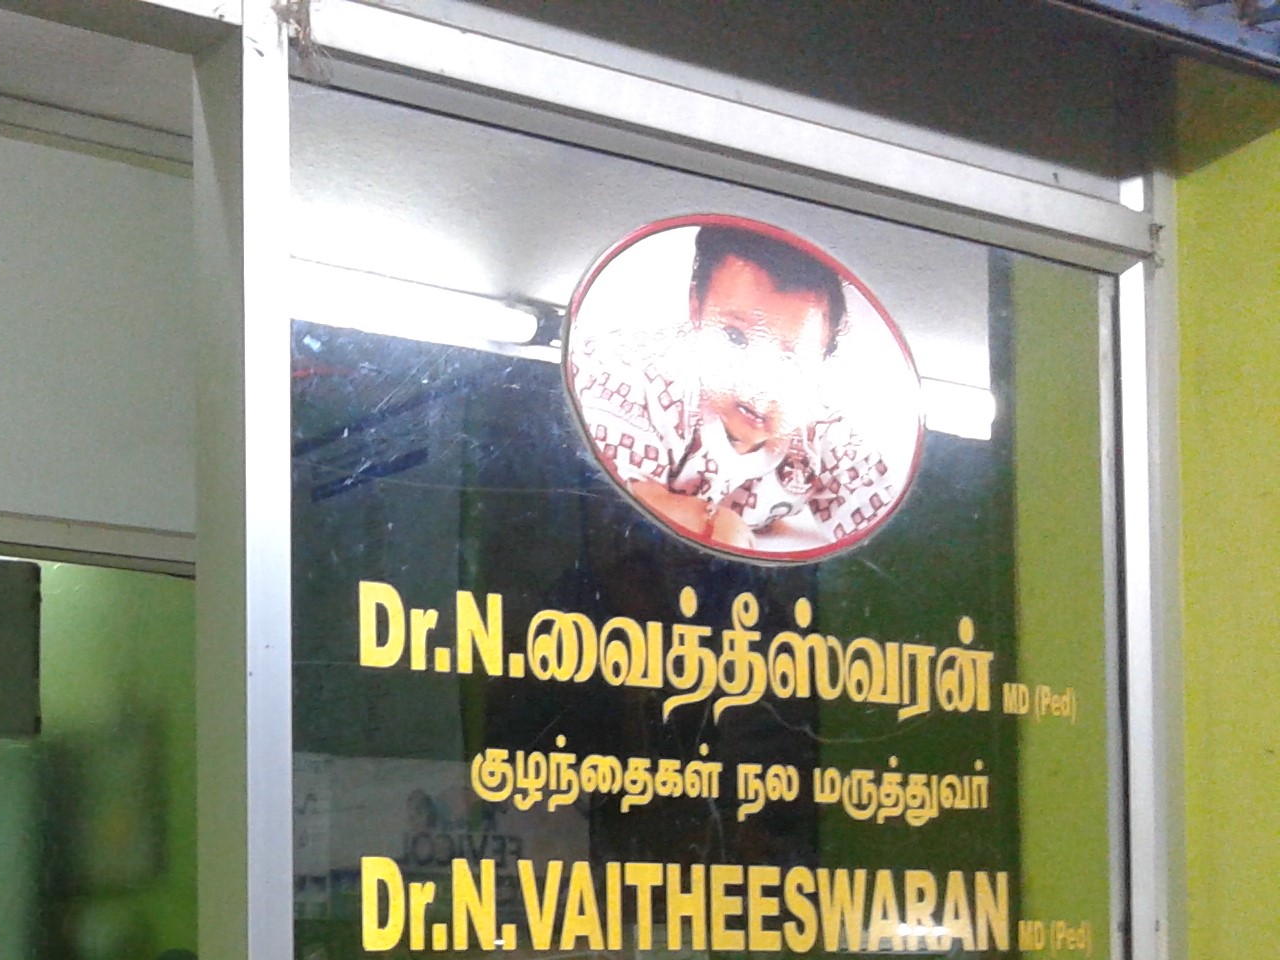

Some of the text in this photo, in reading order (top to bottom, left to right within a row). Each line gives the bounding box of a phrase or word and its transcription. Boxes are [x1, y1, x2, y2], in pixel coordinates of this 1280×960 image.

[359, 580, 997, 727] Dr.N.வைத்தீஸ்வரன்
[1002, 682, 1029, 715] MD
[470, 734, 990, 827] குழந்தைகள் நல மருத்துவர்
[360, 856, 1010, 952] Dr.N.VAITHEESWARAN
[1018, 919, 1045, 951] MD
